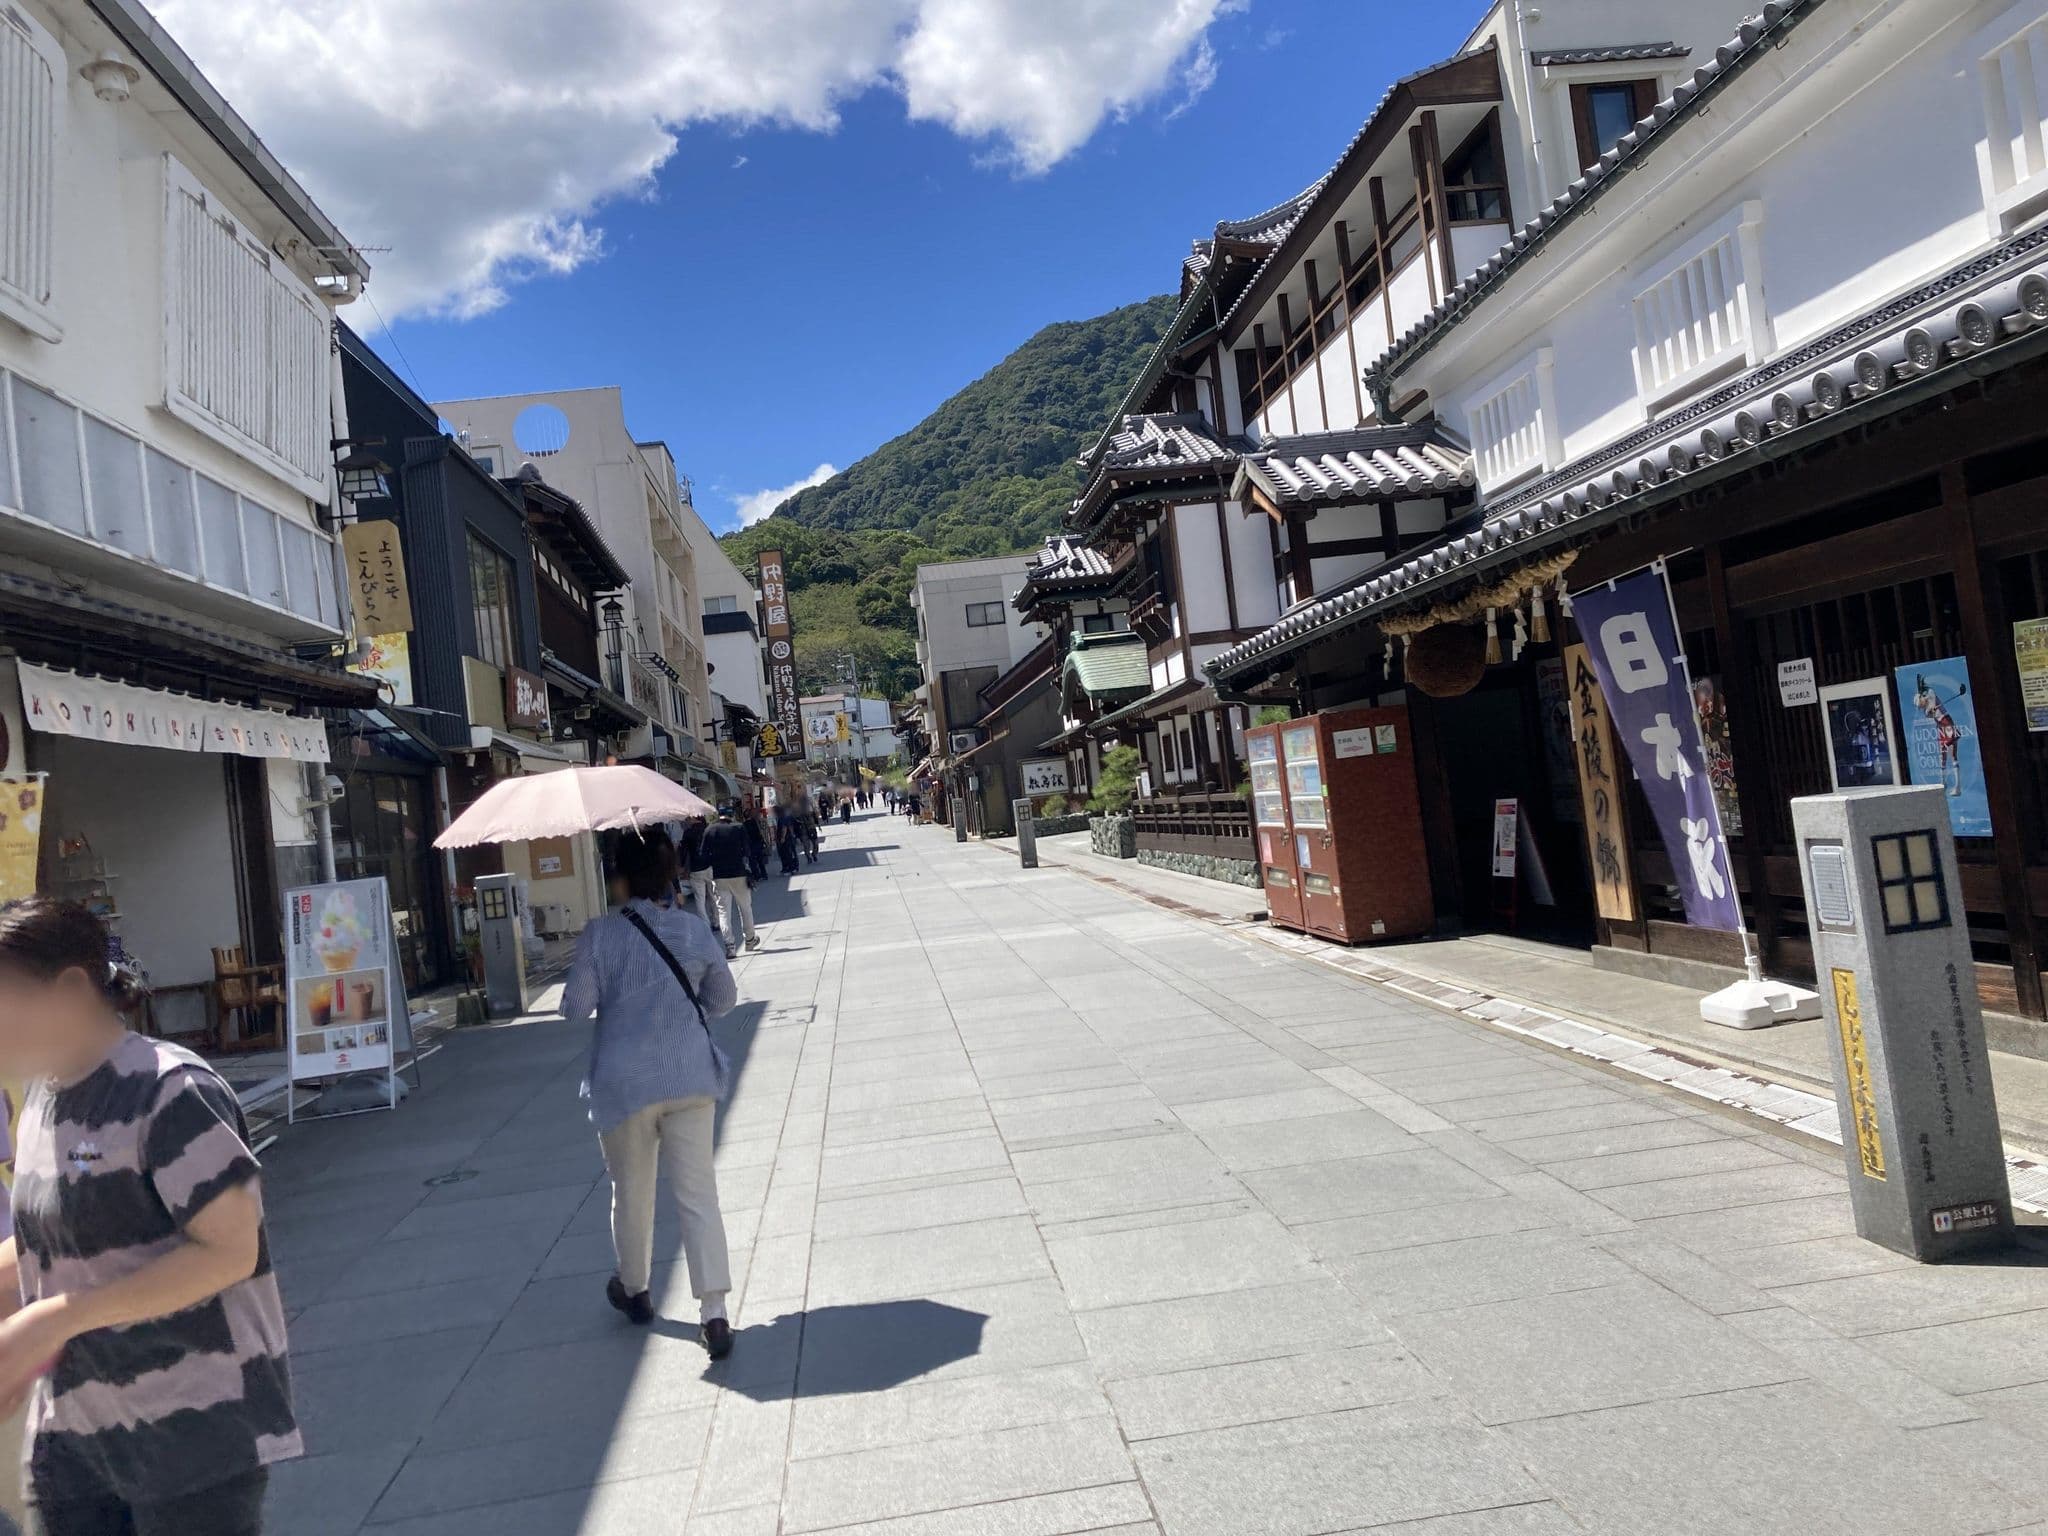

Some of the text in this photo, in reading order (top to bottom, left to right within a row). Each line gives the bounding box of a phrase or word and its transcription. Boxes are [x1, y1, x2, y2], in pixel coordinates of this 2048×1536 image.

[378, 540, 400, 600] ようこそ
[762, 562, 788, 625] 中野屋
[772, 665, 782, 693] Nakano
[776, 694, 784, 713] Udon
[780, 664, 800, 737] 中野うどん学校
[32, 693, 198, 741] KOTOHIRA
